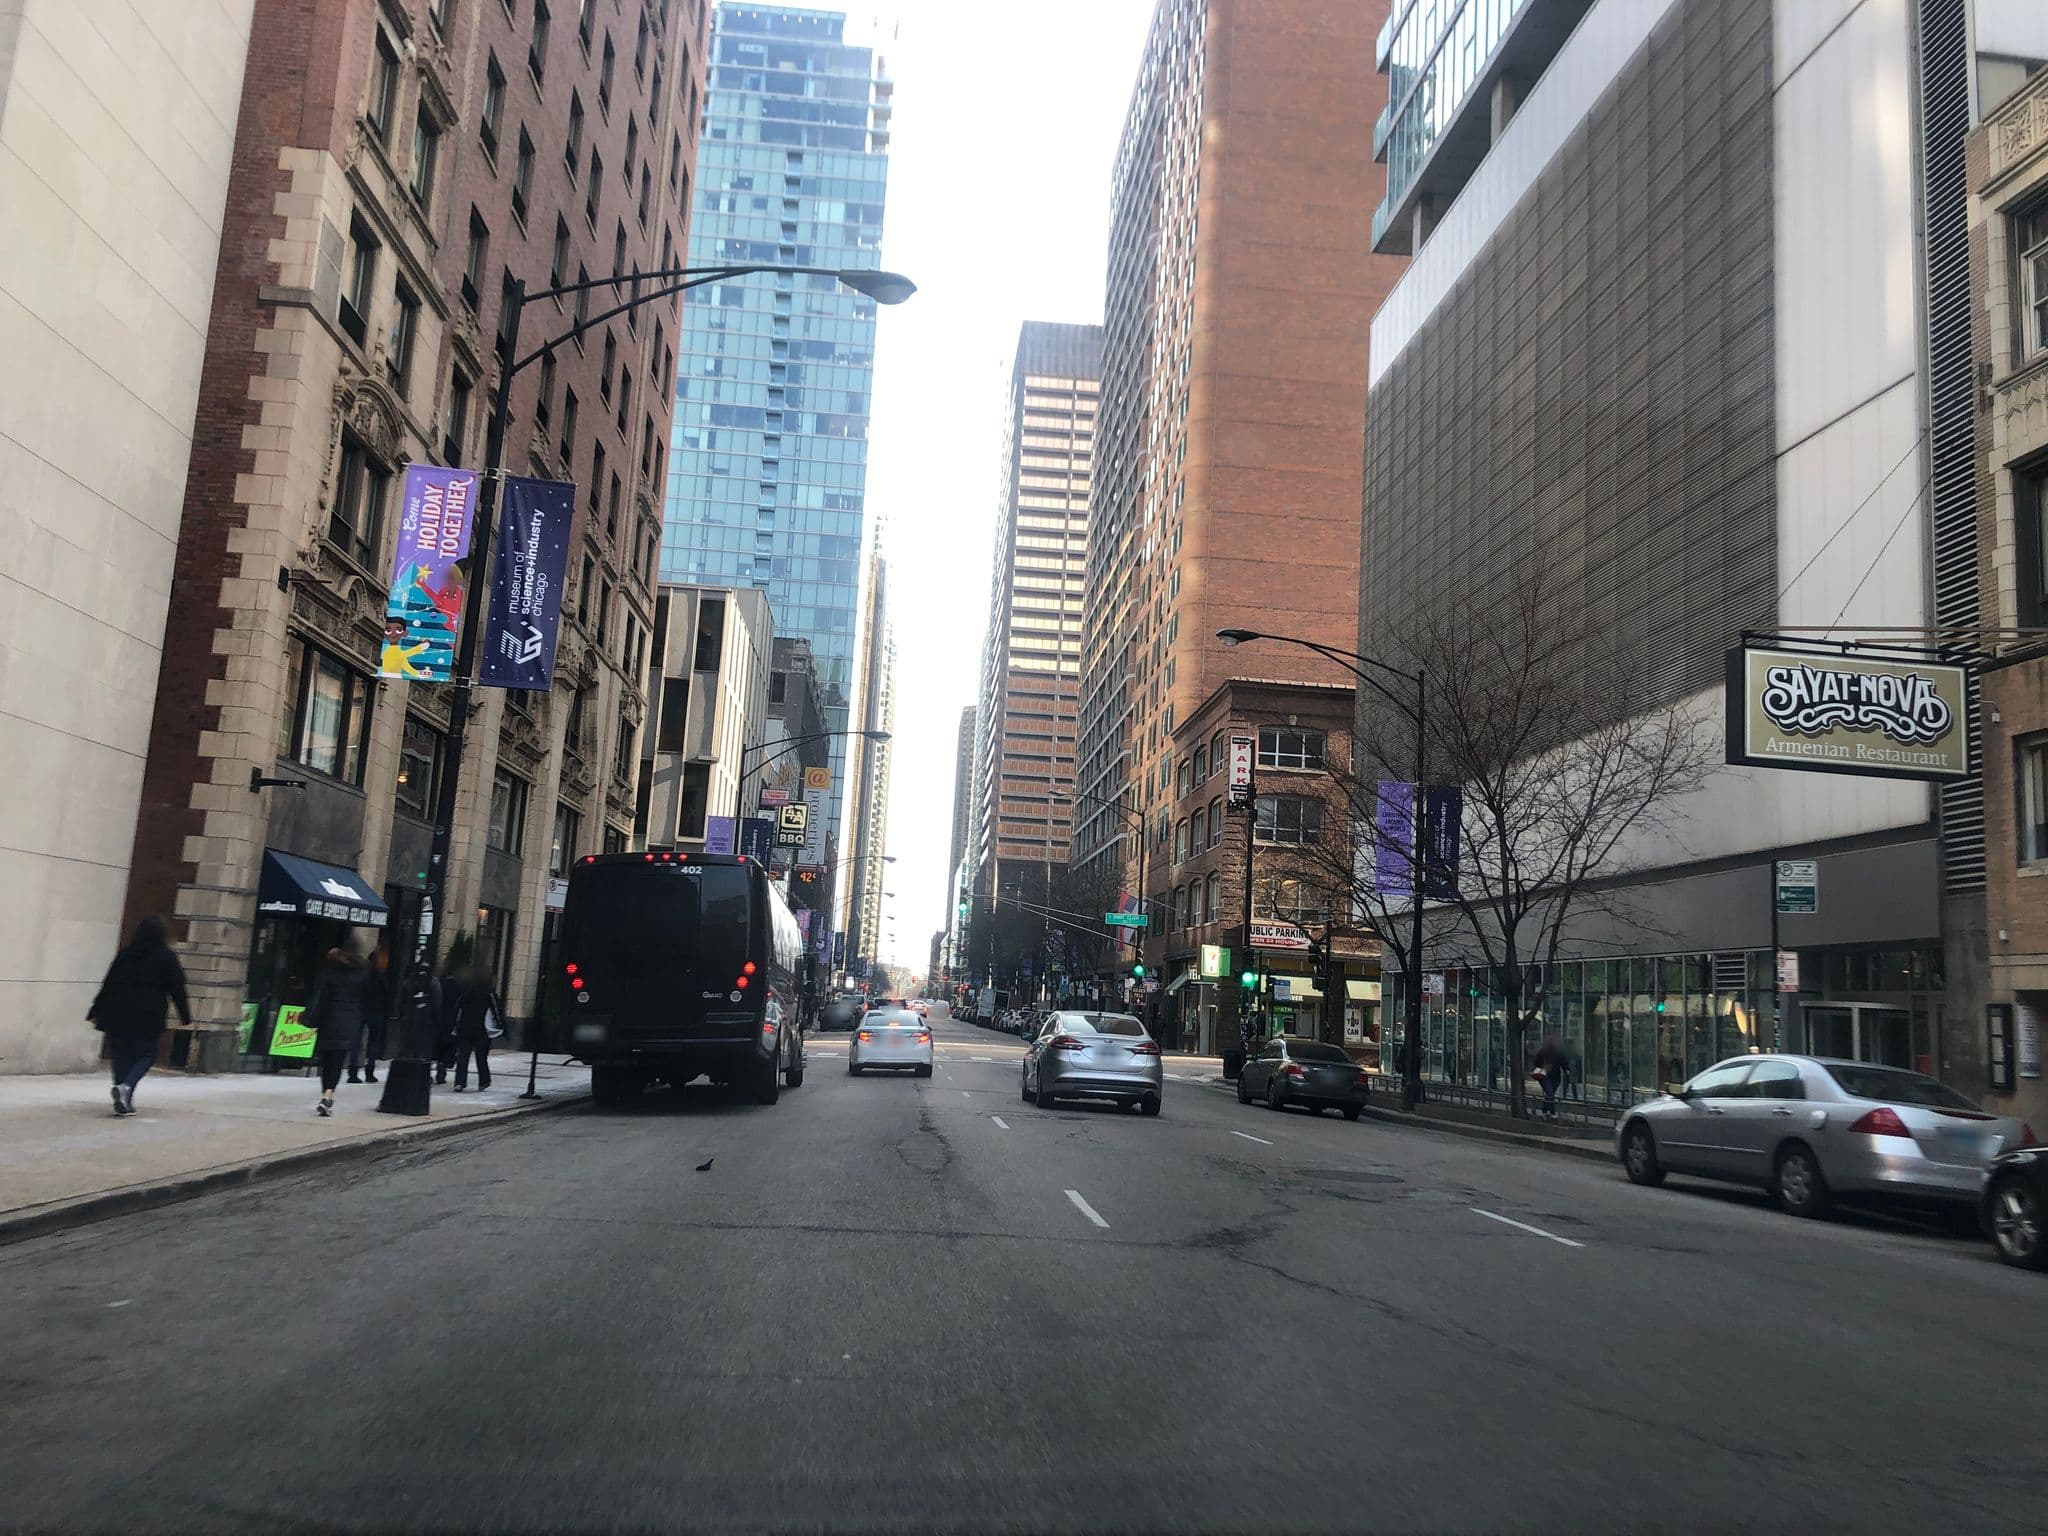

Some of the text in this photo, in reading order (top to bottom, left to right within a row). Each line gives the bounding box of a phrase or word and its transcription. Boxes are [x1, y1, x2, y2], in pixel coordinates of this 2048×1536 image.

[402, 497, 421, 531] Come
[416, 483, 445, 550] HOLIDAY
[439, 475, 475, 559] TOGETHER
[509, 550, 525, 614] museum of
[521, 509, 545, 615] science+industry
[531, 572, 549, 617] chicago
[1764, 664, 1948, 729] SAYAT-NOVA
[1765, 737, 1948, 766] Armenian Restaurant
[779, 834, 805, 845] BBQ
[806, 790, 820, 861] properties
[681, 866, 703, 874] 402
[1250, 926, 1274, 938] UBLIC
